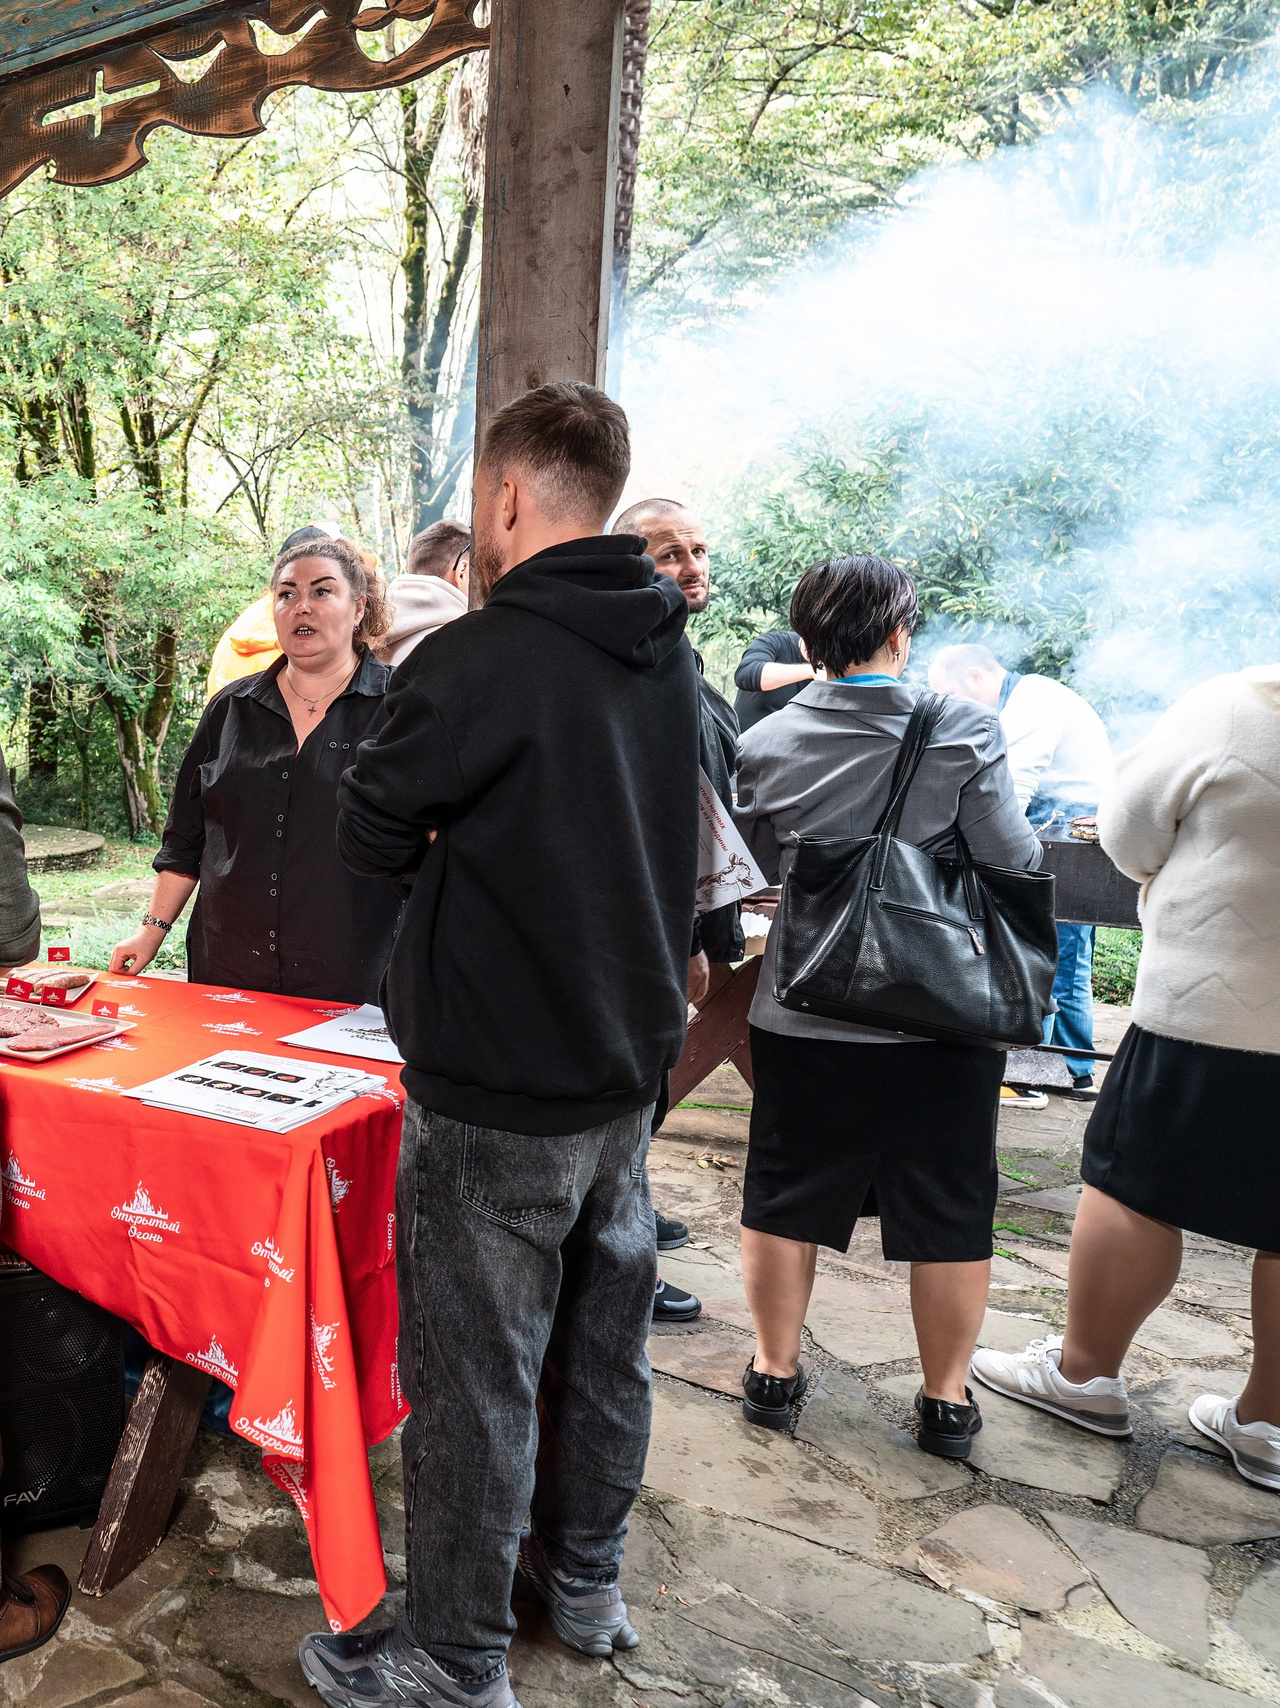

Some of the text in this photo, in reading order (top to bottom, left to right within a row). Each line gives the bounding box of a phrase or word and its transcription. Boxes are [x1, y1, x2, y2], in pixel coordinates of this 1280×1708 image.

[699, 785, 711, 805] итель
[1, 1180, 47, 1201] крытый
[5, 1190, 31, 1210] Огонь
[110, 1205, 181, 1234] Открытый
[127, 1225, 164, 1243] Огонь
